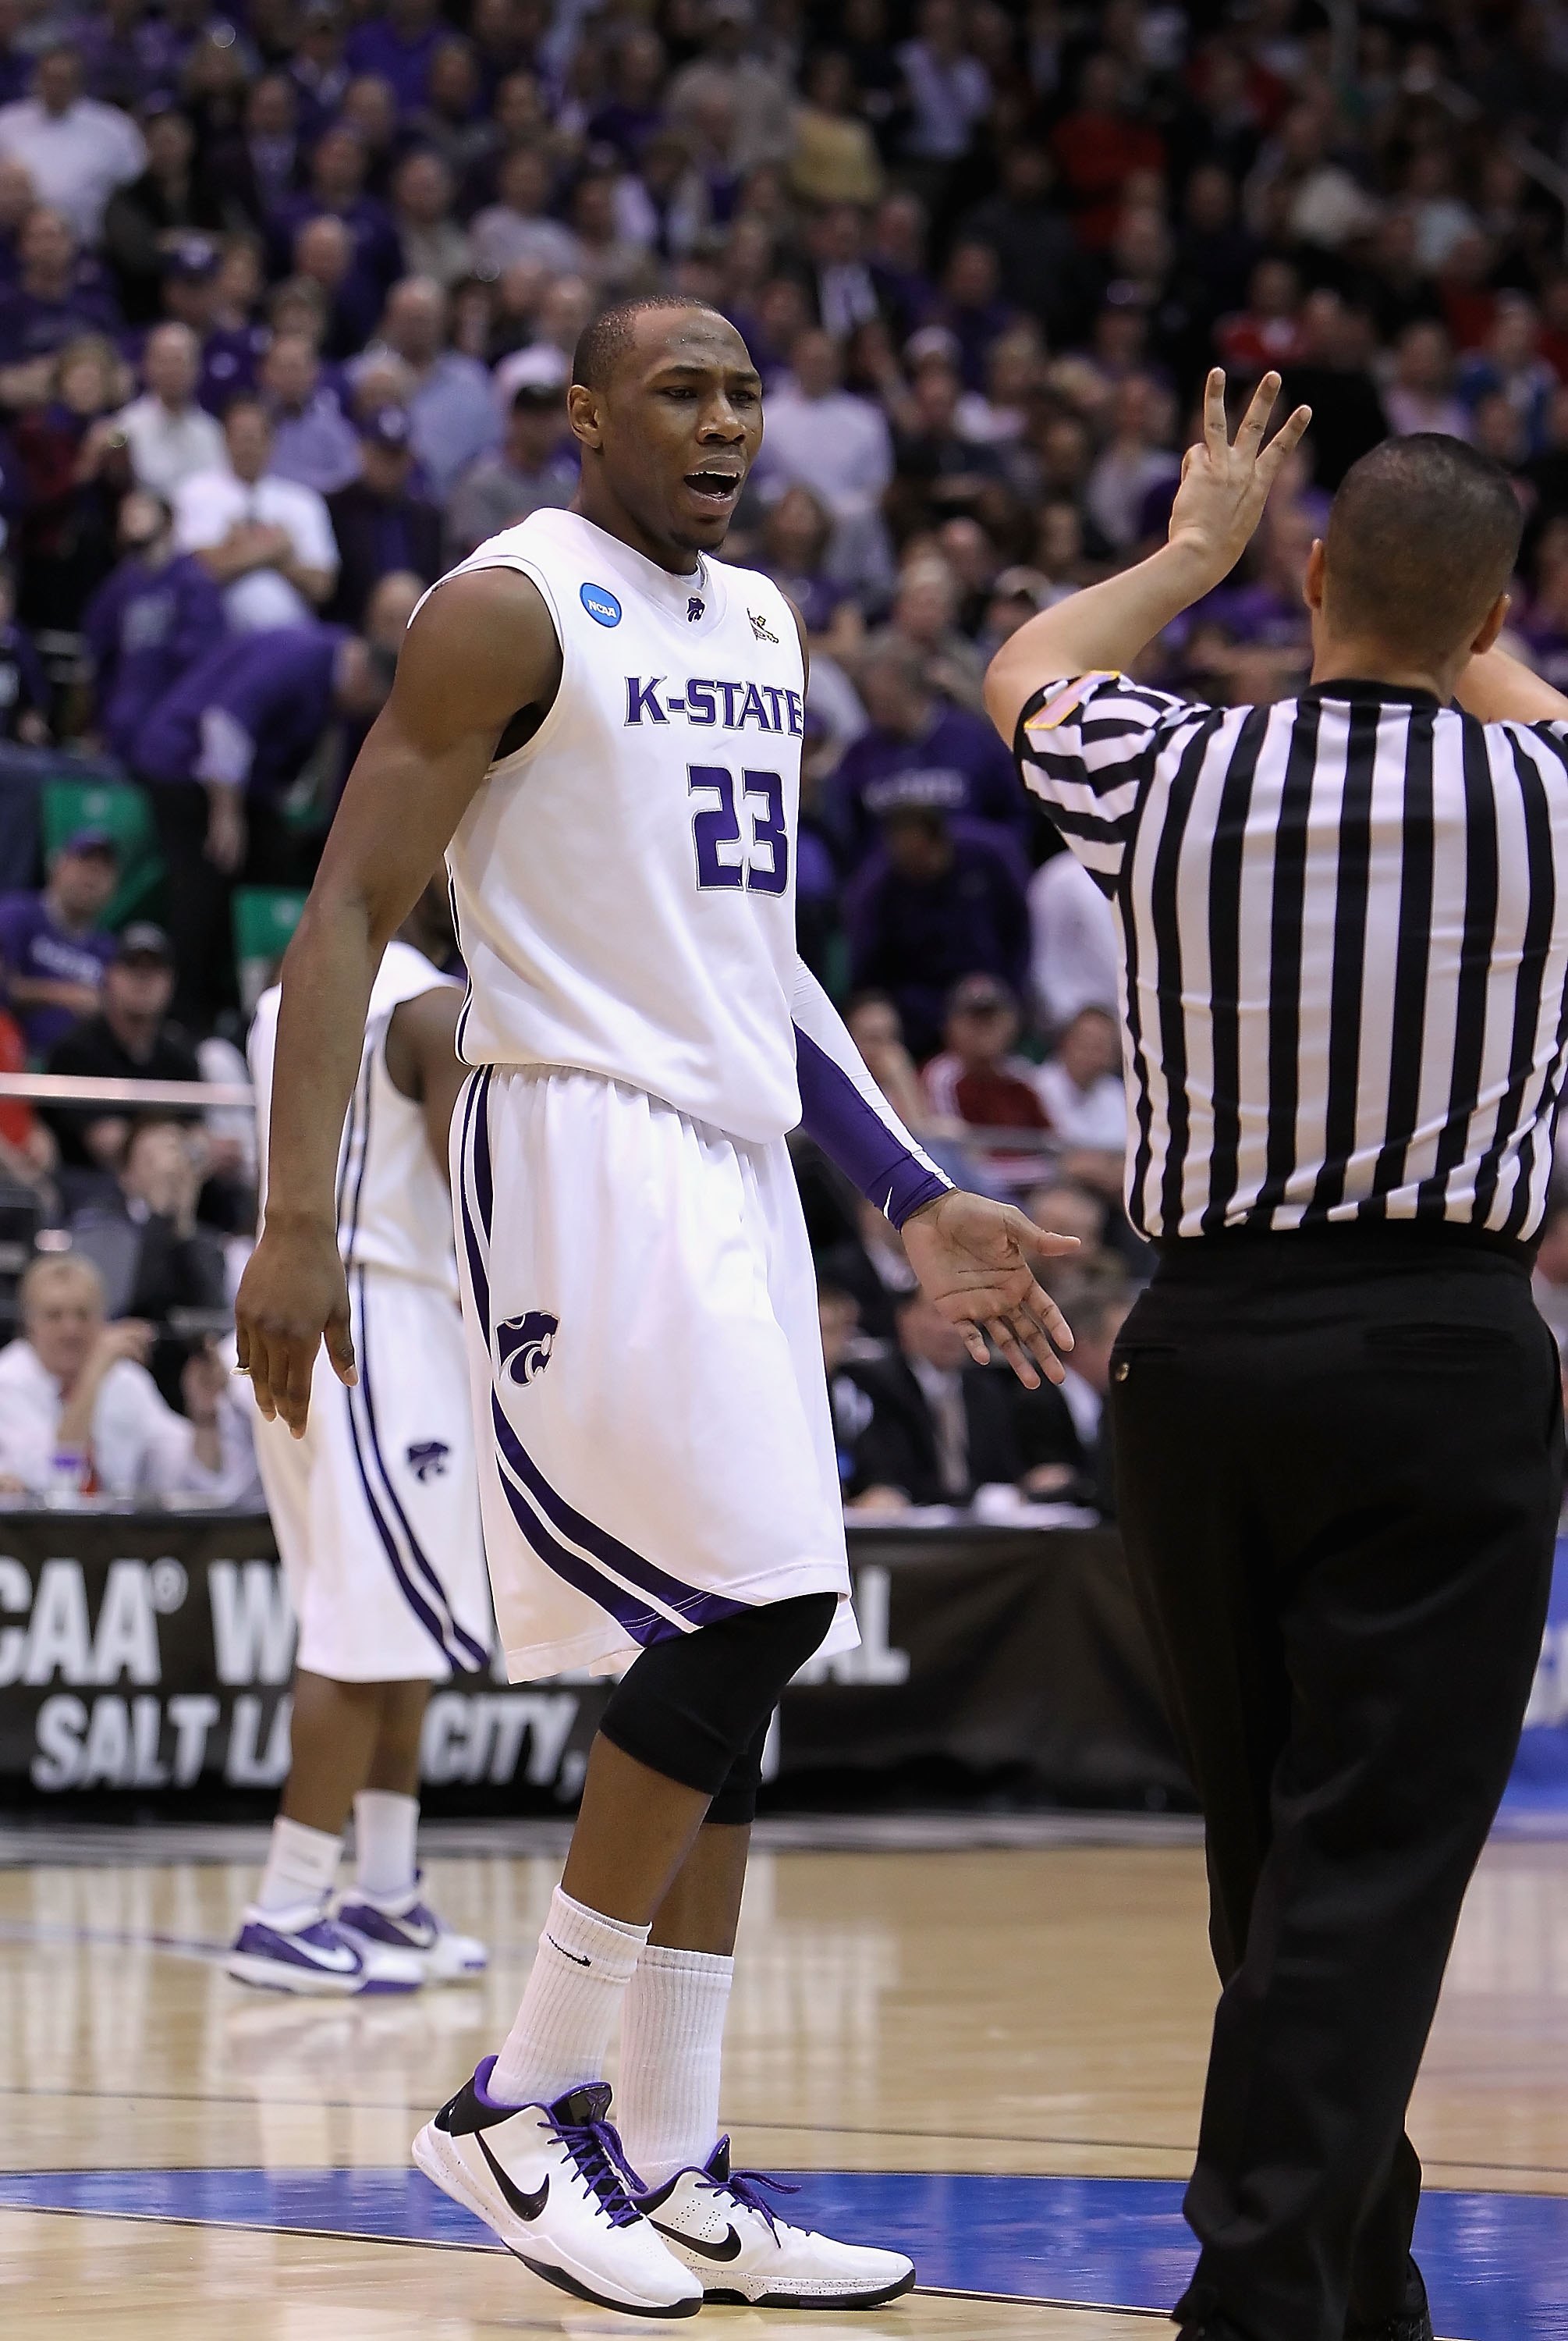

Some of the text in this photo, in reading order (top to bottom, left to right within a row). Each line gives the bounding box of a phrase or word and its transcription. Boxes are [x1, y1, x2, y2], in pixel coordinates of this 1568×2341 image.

[587, 599, 617, 619] NCAA
[624, 676, 804, 739] K-STATE
[686, 762, 789, 897] 23
[30, 1693, 221, 1792] SALT
